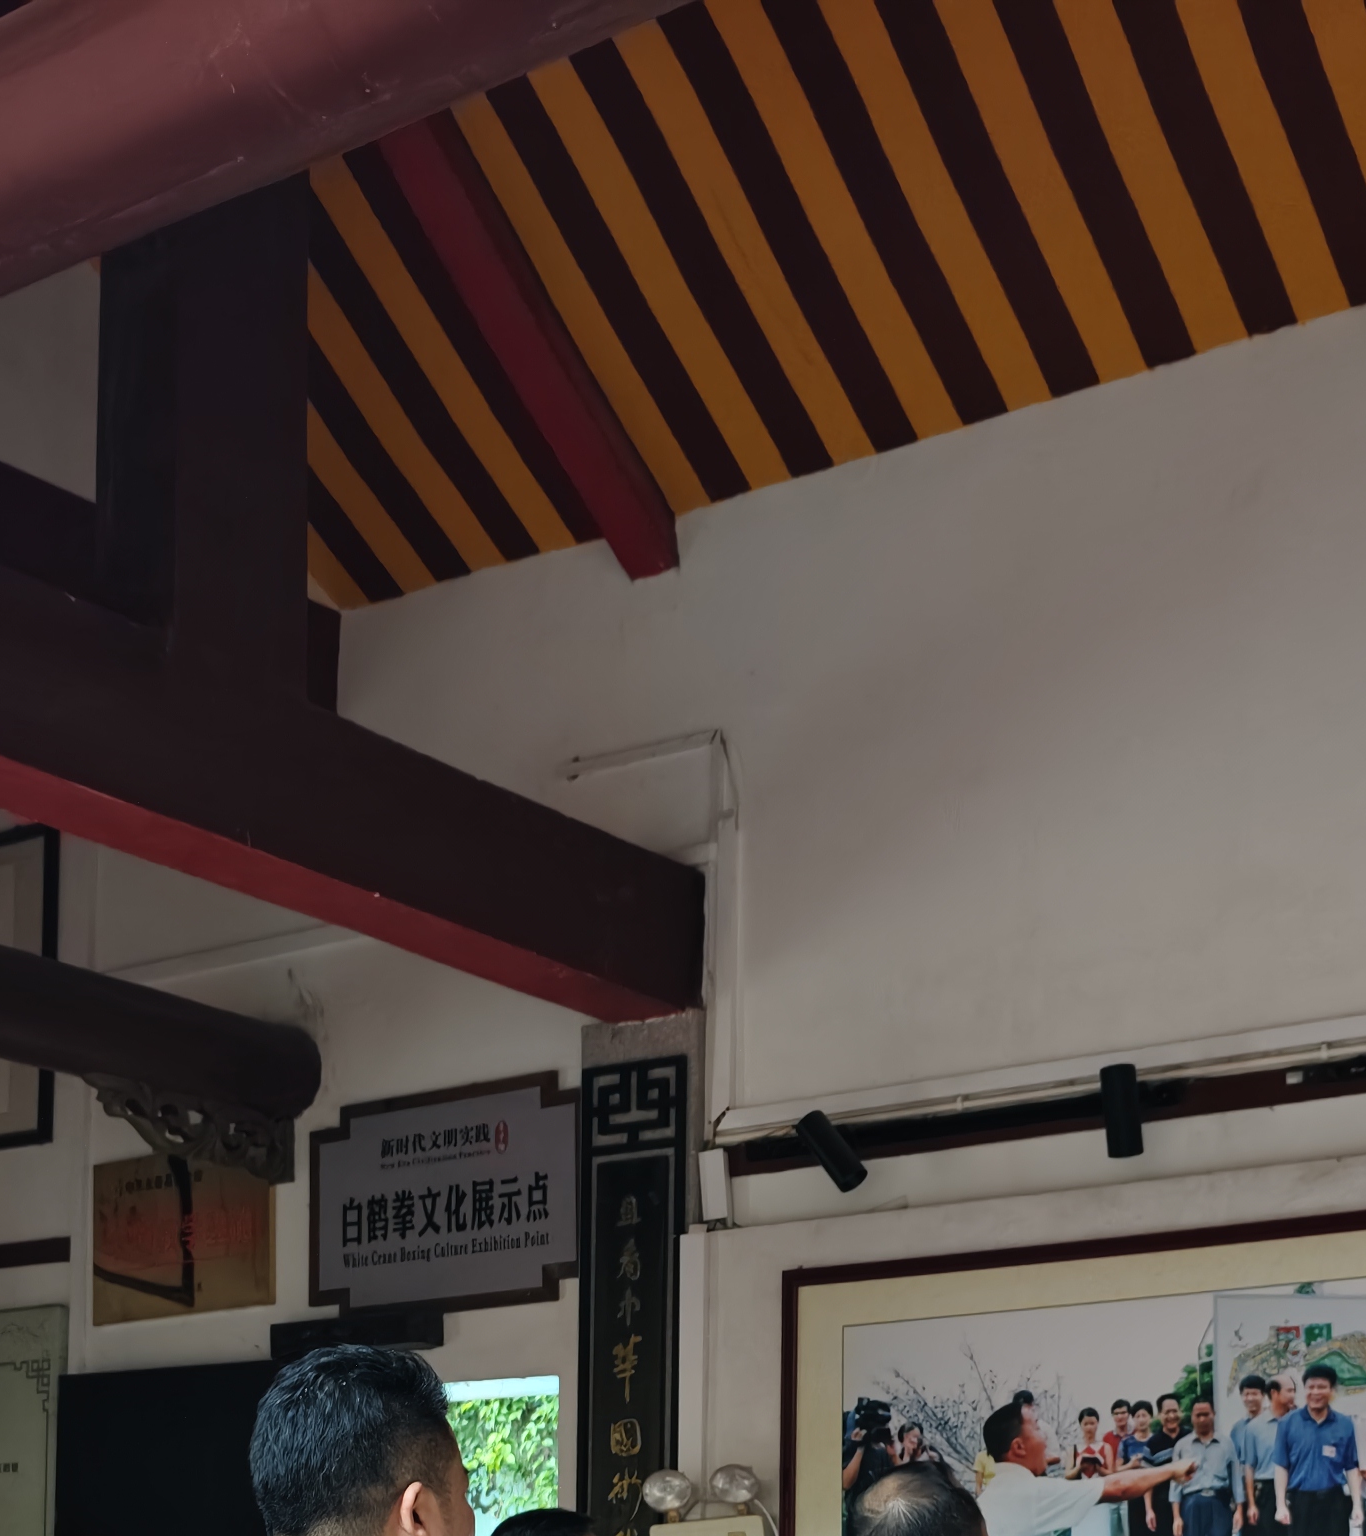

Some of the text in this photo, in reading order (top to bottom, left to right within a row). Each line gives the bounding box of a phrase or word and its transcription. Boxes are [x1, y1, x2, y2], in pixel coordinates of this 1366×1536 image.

[381, 1122, 491, 1159] 新时代文明实践
[342, 1171, 550, 1248] 白鹤拳文化展示点
[343, 1230, 550, 1269] White Crane Boxing Culture Exhibition Point
